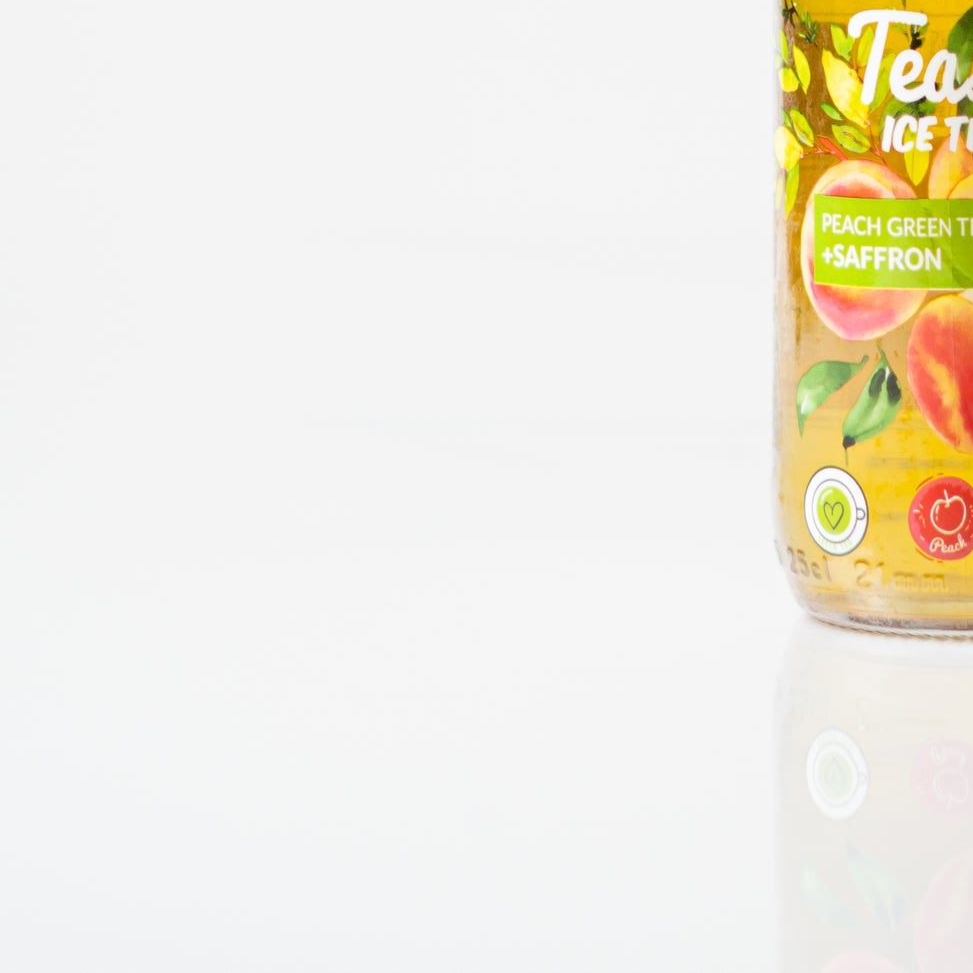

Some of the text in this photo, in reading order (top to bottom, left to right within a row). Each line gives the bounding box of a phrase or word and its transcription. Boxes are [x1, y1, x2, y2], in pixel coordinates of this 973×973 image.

[881, 115, 938, 153] ICE
[822, 213, 882, 237] PEACH
[887, 217, 952, 237] GREEN
[822, 244, 942, 271] +SAFFRON
[929, 533, 967, 553] Peach
